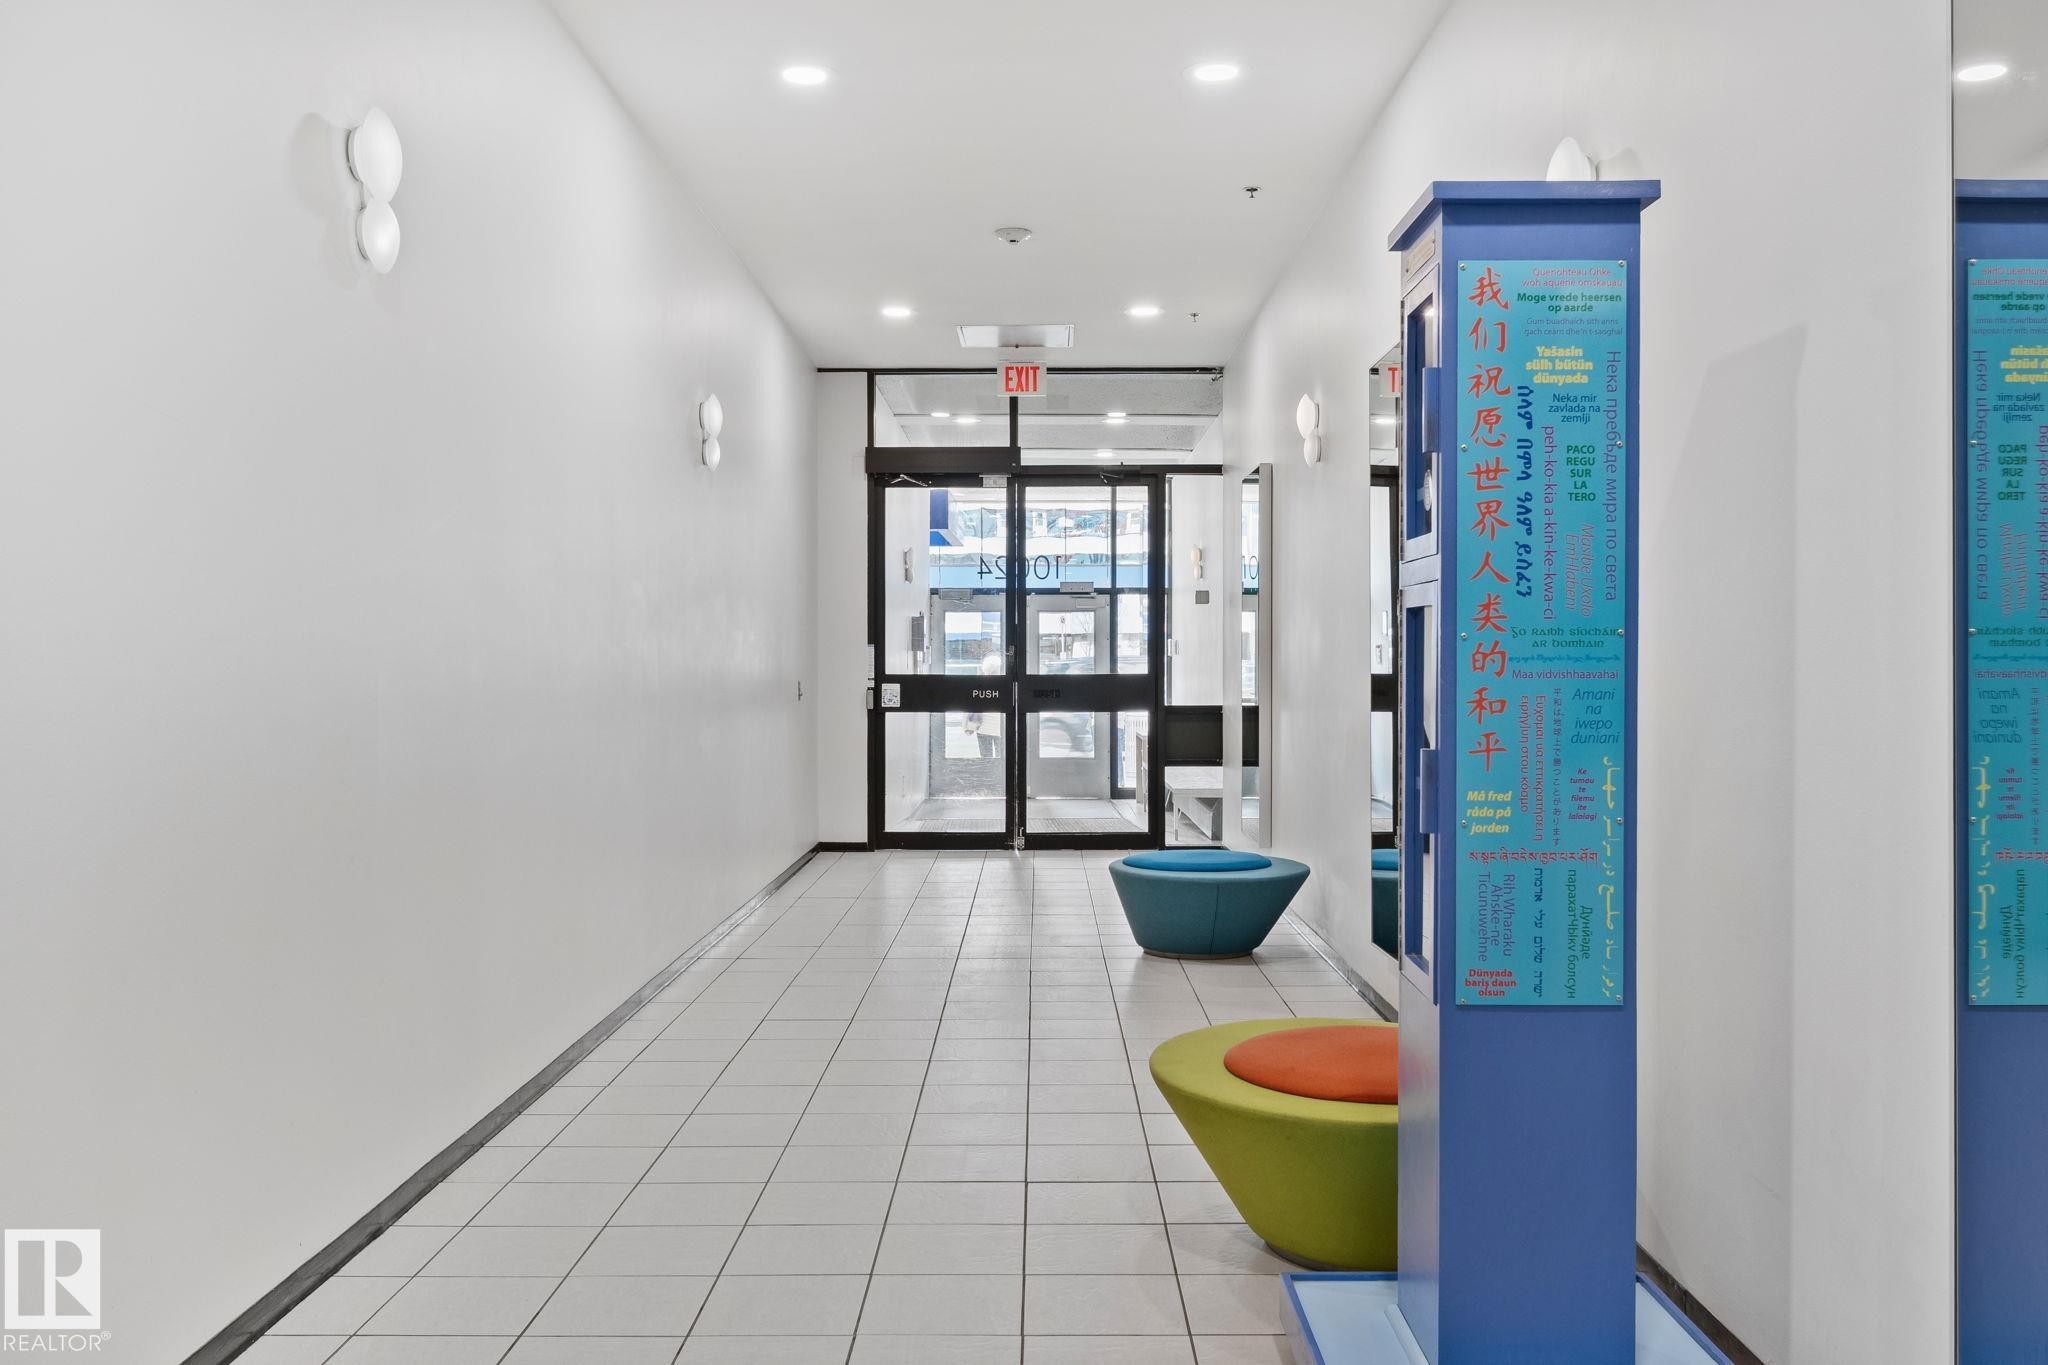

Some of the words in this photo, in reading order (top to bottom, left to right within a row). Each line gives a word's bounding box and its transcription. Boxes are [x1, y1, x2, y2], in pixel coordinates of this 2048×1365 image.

[1517, 293, 1546, 303] Moge
[1549, 292, 1578, 301] vrede
[1581, 292, 1622, 301] heersen
[1548, 304, 1561, 313] op
[1564, 303, 1593, 312] aarde
[1606, 351, 1621, 393] Нека
[1005, 366, 1040, 392] EXIT
[1552, 393, 1577, 402] Neka
[1580, 394, 1597, 402] mir
[1548, 403, 1585, 413] zavlada
[1561, 413, 1590, 424] zemlji
[1567, 445, 1595, 454] PACO
[1541, 426, 1558, 503] peh-ko-kia
[1567, 457, 1595, 466] REGU
[1570, 468, 1592, 478] SUR
[1573, 481, 1587, 489] LA
[1568, 492, 1596, 501] TERO
[1603, 478, 1617, 523] мира
[1466, 266, 1511, 773] 我们祝愿世界人类的和平
[1606, 528, 1617, 550] по
[1605, 554, 1617, 600] света
[1512, 670, 1534, 679] Maa
[972, 690, 999, 698] PUSH
[1572, 688, 1616, 700] Amani
[1585, 706, 1602, 715] na
[1575, 718, 1613, 731] iwepo
[1571, 732, 1620, 744] duniani
[1467, 790, 1485, 801] Må
[1487, 790, 1512, 801] fred
[1470, 822, 1510, 836] jorden
[1469, 968, 1512, 978] Dünyada
[1492, 979, 1516, 987] daun
[1478, 987, 1505, 996] olsun
